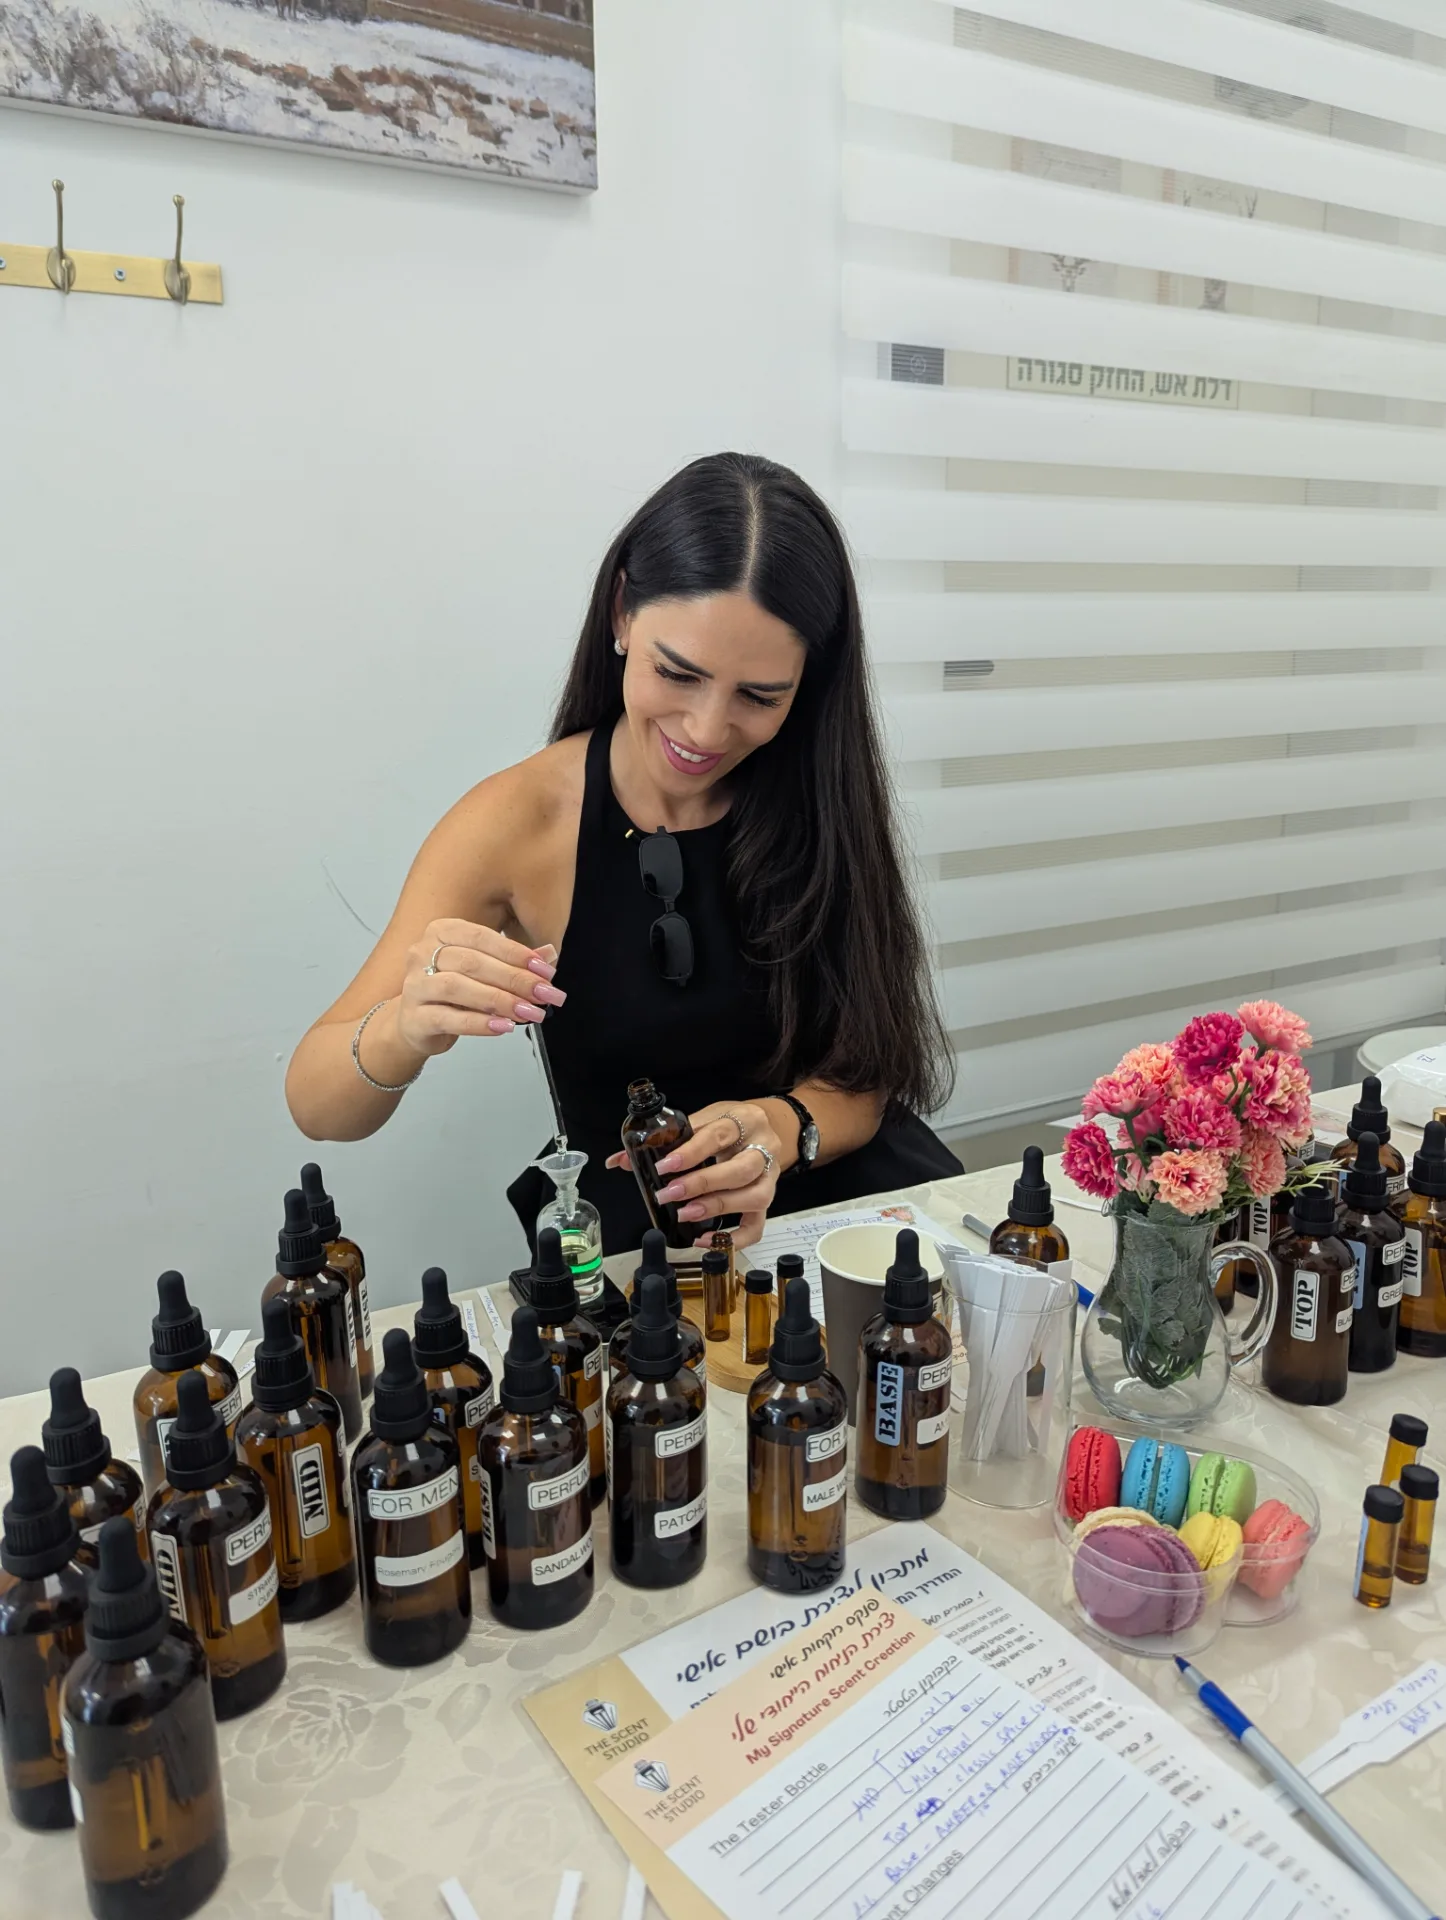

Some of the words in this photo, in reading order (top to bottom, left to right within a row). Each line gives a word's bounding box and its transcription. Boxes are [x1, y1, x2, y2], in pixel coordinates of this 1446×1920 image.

[1016, 356, 1083, 387] סגורה
[1089, 364, 1145, 395] החזק
[1192, 376, 1232, 401] דלת
[1253, 1201, 1268, 1235] TOP
[1402, 1241, 1419, 1279] TOP
[1294, 1279, 1315, 1330] TOP
[878, 1364, 899, 1440] BASE
[807, 1432, 841, 1456] FOR
[300, 1459, 325, 1522] MID
[370, 1495, 413, 1515] FOR
[421, 1476, 459, 1507] MEN
[806, 1486, 836, 1505] MALE
[377, 1564, 427, 1579] Rosemary
[870, 1547, 930, 1592] מתכון
[915, 1567, 963, 1599] המדריך
[801, 1567, 863, 1627] ליצירת
[845, 1597, 881, 1628] פנקס
[734, 1618, 796, 1660] בושם
[861, 1611, 897, 1650] יצירת
[676, 1648, 728, 1684] אישי
[769, 1654, 799, 1680] אישי
[814, 1643, 860, 1683] הניחוח
[918, 1654, 960, 1695] בקבוקון
[745, 1742, 773, 1765] My
[767, 1697, 832, 1748] Signature
[828, 1670, 867, 1701] Scent
[863, 1630, 917, 1672] Creation
[759, 1679, 812, 1721] הייחודי
[882, 1686, 919, 1719] הטסטר
[584, 1737, 612, 1757] THE
[610, 1717, 650, 1744] SCENT
[602, 1730, 651, 1761] STUDIO
[731, 1712, 758, 1743] שלי
[1021, 1757, 1057, 1794] רכיבים
[644, 1798, 670, 1821] THE
[666, 1773, 704, 1805] SCENT
[663, 1788, 707, 1824] STUDIO
[708, 1832, 741, 1856] The
[736, 1795, 786, 1834] Tester
[783, 1761, 829, 1798] Bottle
[902, 1848, 964, 1904] Changes
